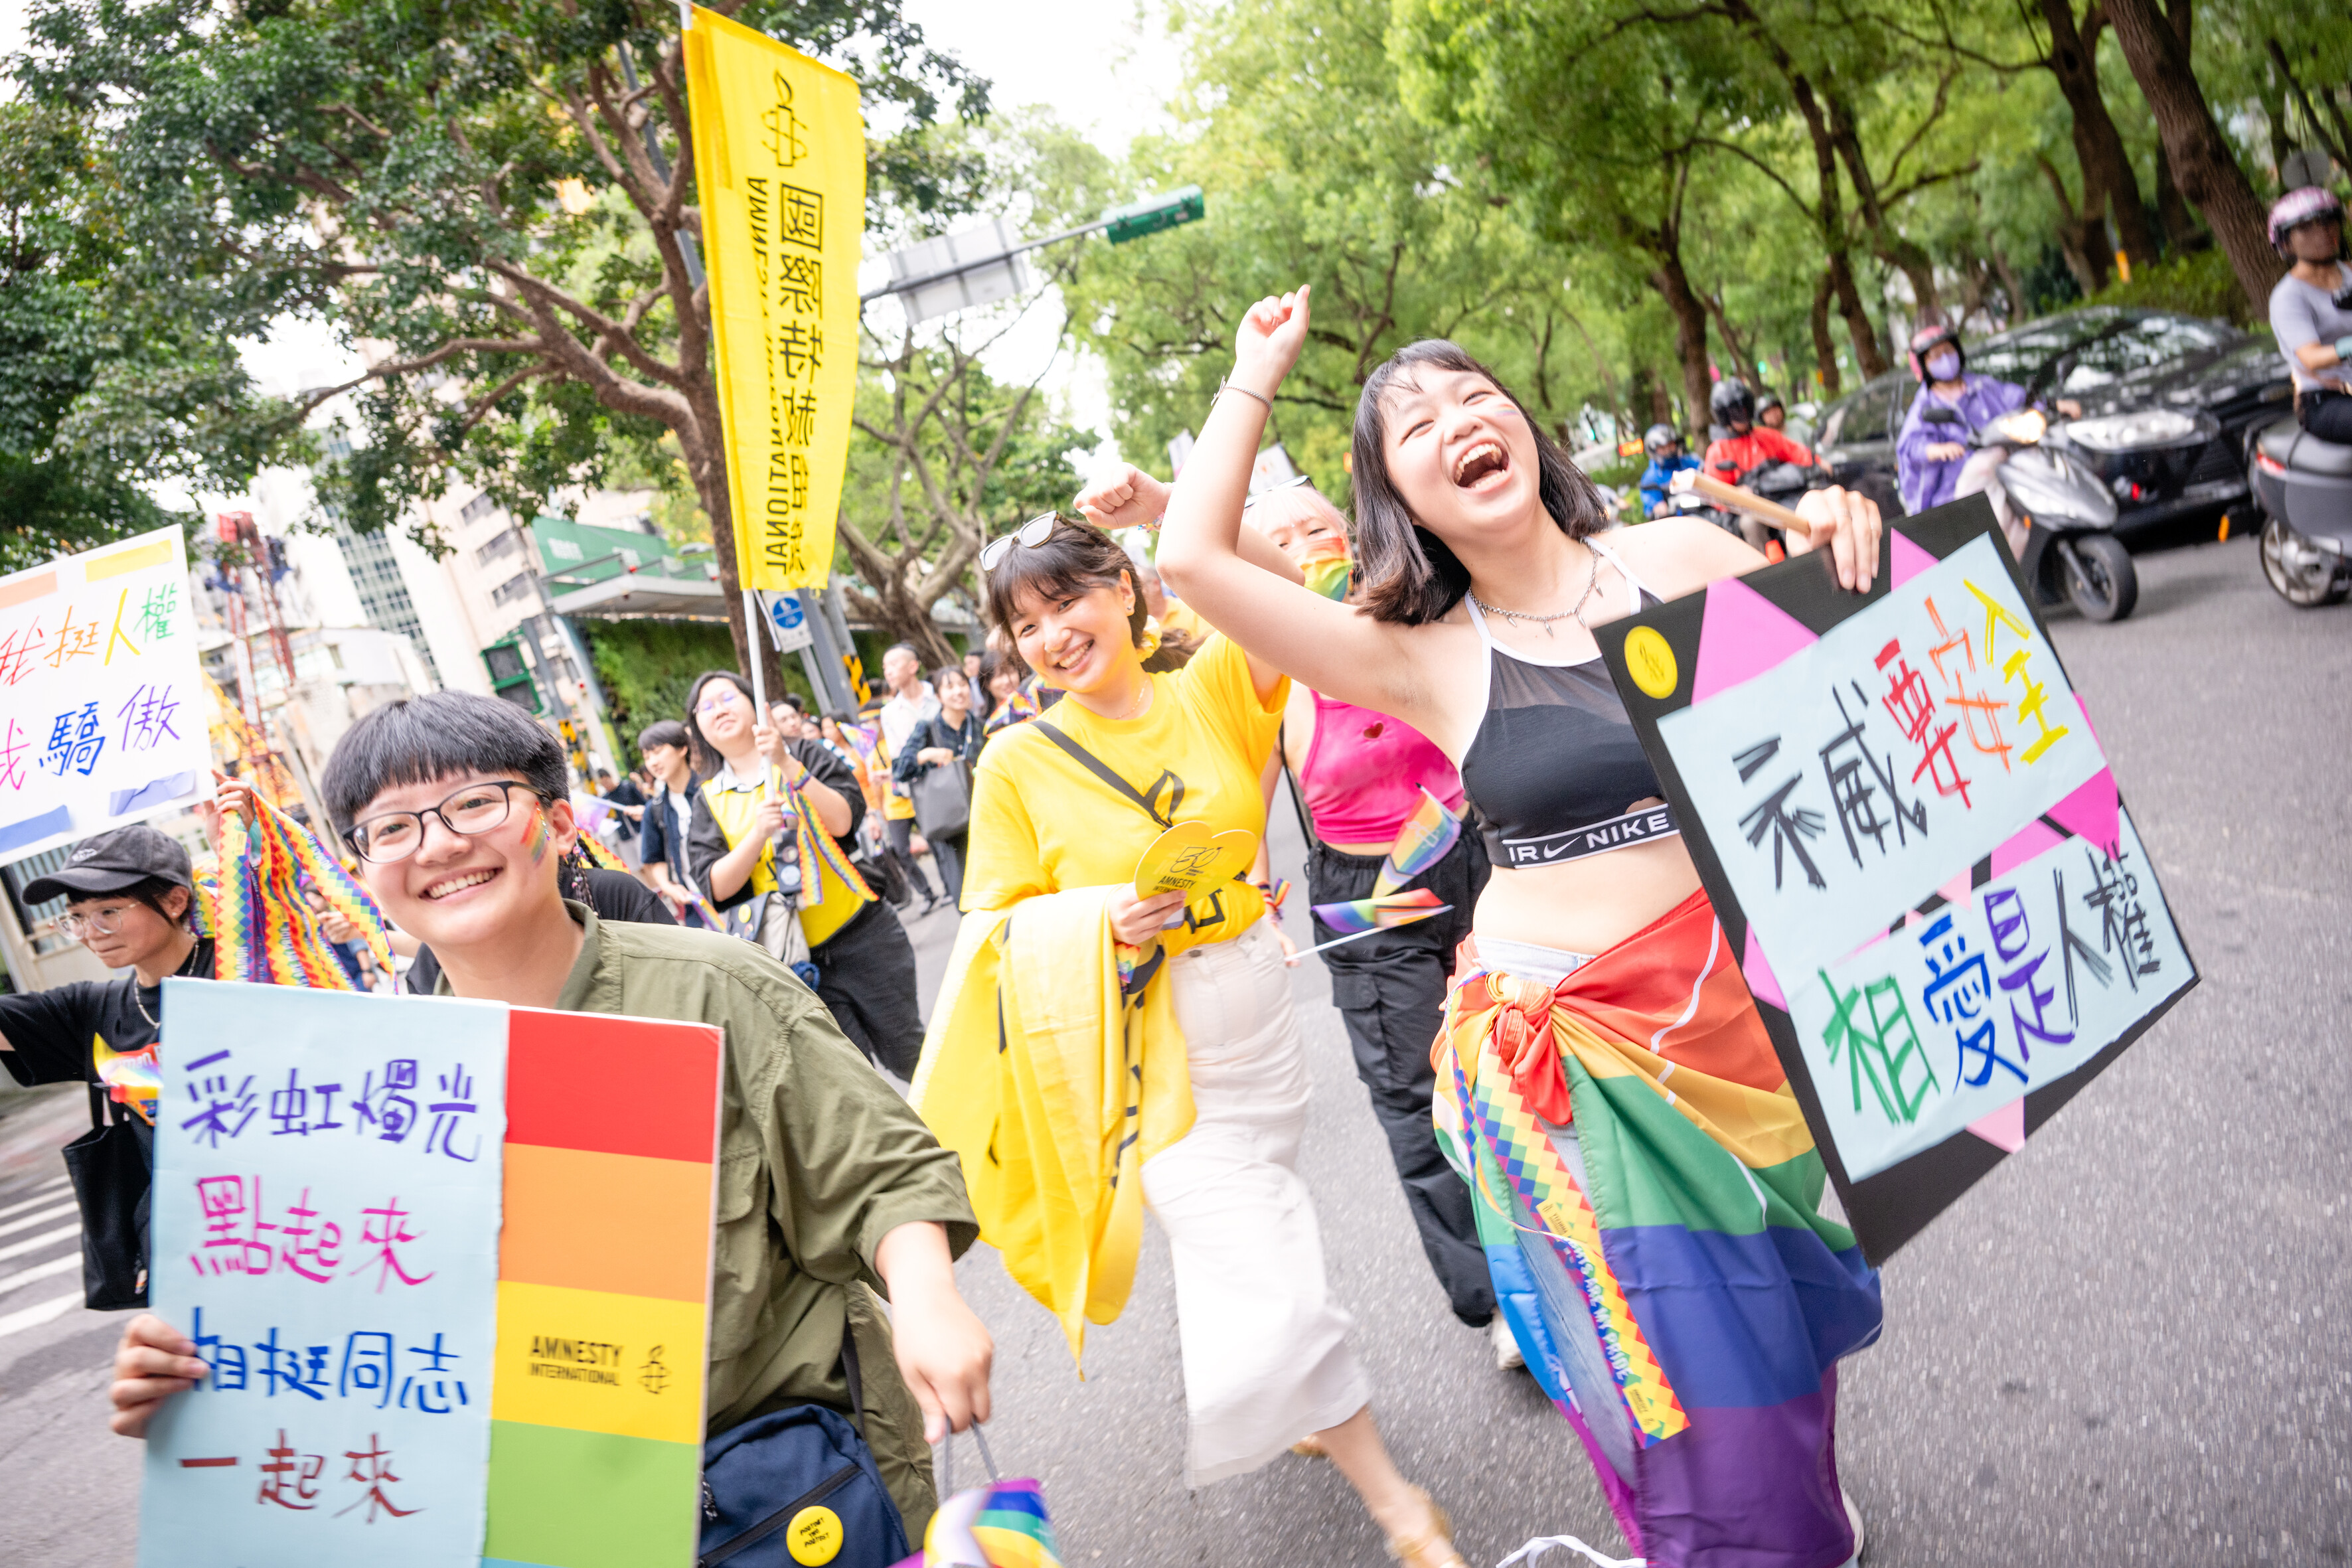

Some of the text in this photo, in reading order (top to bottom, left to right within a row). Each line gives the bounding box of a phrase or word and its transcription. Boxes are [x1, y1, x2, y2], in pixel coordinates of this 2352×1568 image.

[0, 582, 178, 686] 我挺人權
[1585, 812, 1670, 849] NIKE
[1158, 876, 1196, 890] AMNESTY
[1818, 839, 2161, 1126] 相愛是人權
[181, 1050, 483, 1162] 彩虹燭光
[189, 1174, 437, 1294] 點起來
[1584, 1277, 1605, 1307] ARE
[1593, 1307, 1614, 1330] MY
[193, 1306, 469, 1414] 相挺同志
[526, 1362, 622, 1386] INTERNATIONAL
[528, 1335, 625, 1367] AMNESTY
[1602, 1332, 1635, 1381] PRIDE
[179, 1428, 428, 1524] 一起來
